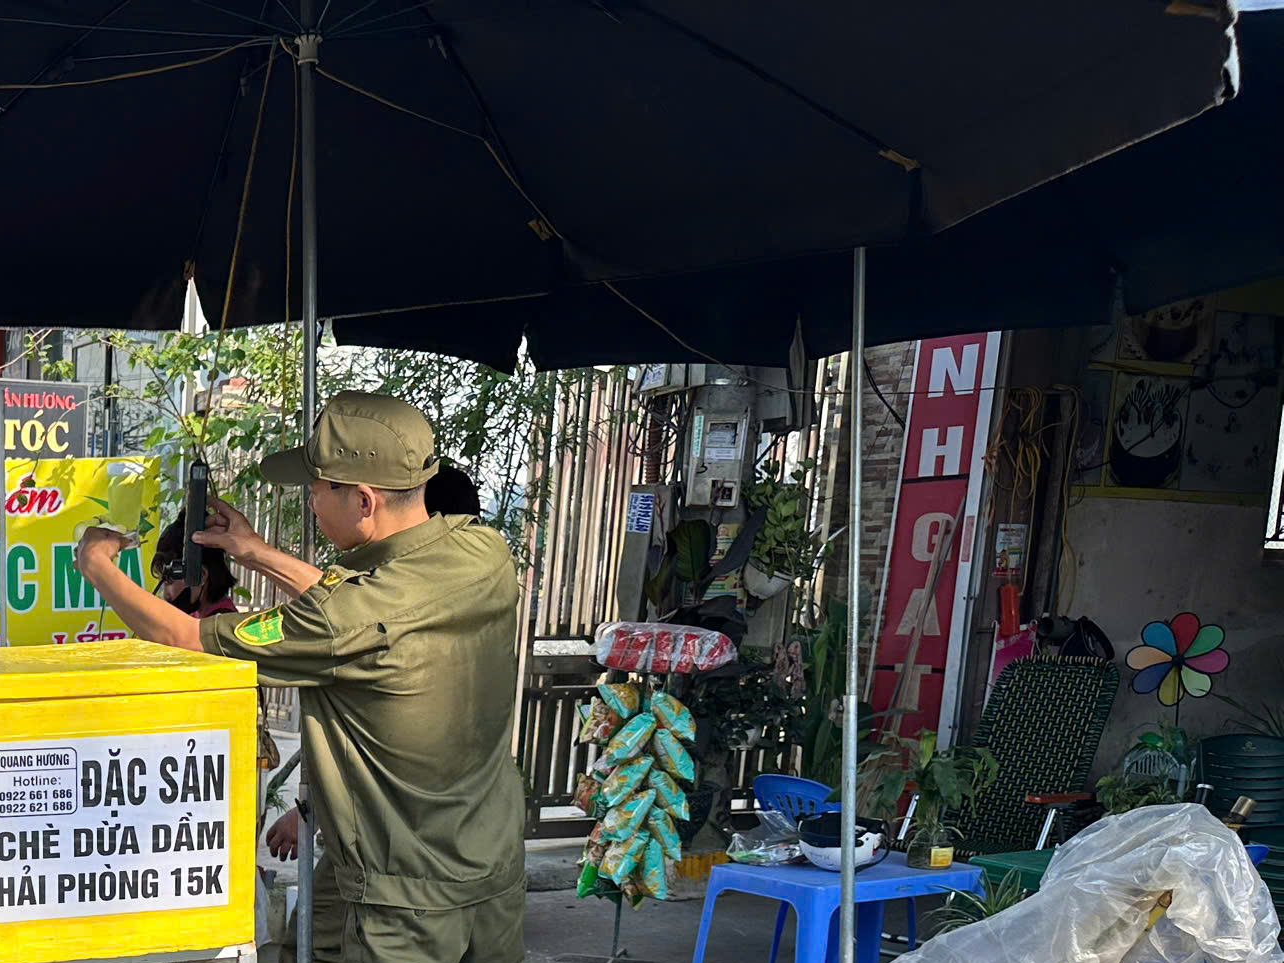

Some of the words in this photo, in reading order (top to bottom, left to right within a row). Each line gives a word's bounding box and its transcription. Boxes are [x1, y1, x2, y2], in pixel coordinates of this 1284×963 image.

[0, 755, 33, 769] QUANG
[36, 753, 70, 767] HƯƠNG
[13, 776, 62, 786] Hotline:
[81, 748, 147, 818] ĐẶC
[159, 738, 225, 804] SẢN
[0, 791, 26, 801] 0922
[29, 789, 48, 800] 661
[52, 788, 73, 799] 686
[0, 803, 26, 814] 0922
[29, 802, 48, 812] 621
[52, 801, 73, 811] 686
[73, 820, 140, 857] DỪA
[152, 812, 225, 853] DẦM
[57, 863, 159, 904] PHÒNG
[170, 864, 224, 897] 15K
